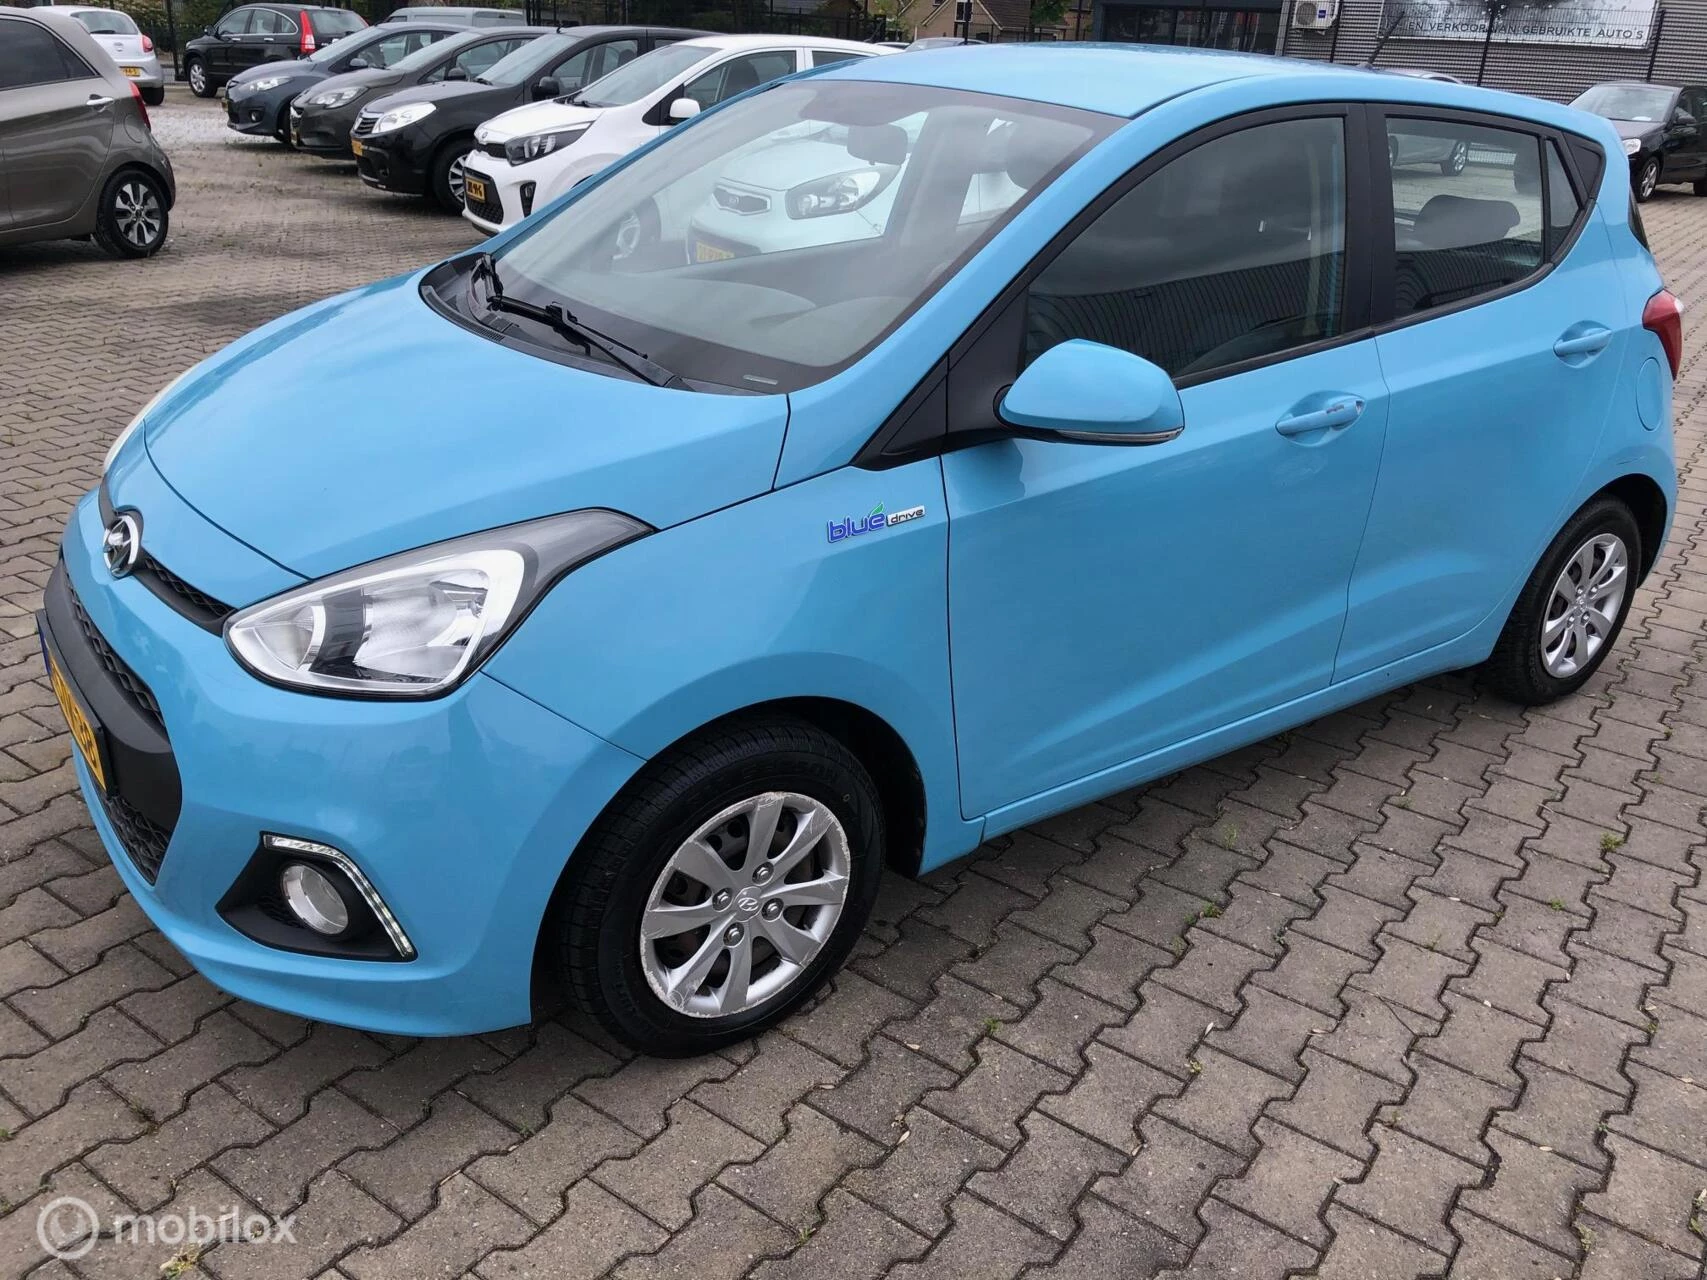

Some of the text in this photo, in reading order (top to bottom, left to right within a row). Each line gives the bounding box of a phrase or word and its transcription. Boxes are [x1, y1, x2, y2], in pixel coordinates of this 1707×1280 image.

[1408, 22, 1424, 31] EN
[1429, 22, 1486, 33] VERKOOP
[1522, 25, 1592, 37] GEBRUIKTE
[1596, 27, 1644, 40] AUTO'S
[828, 508, 924, 542] blue drive
